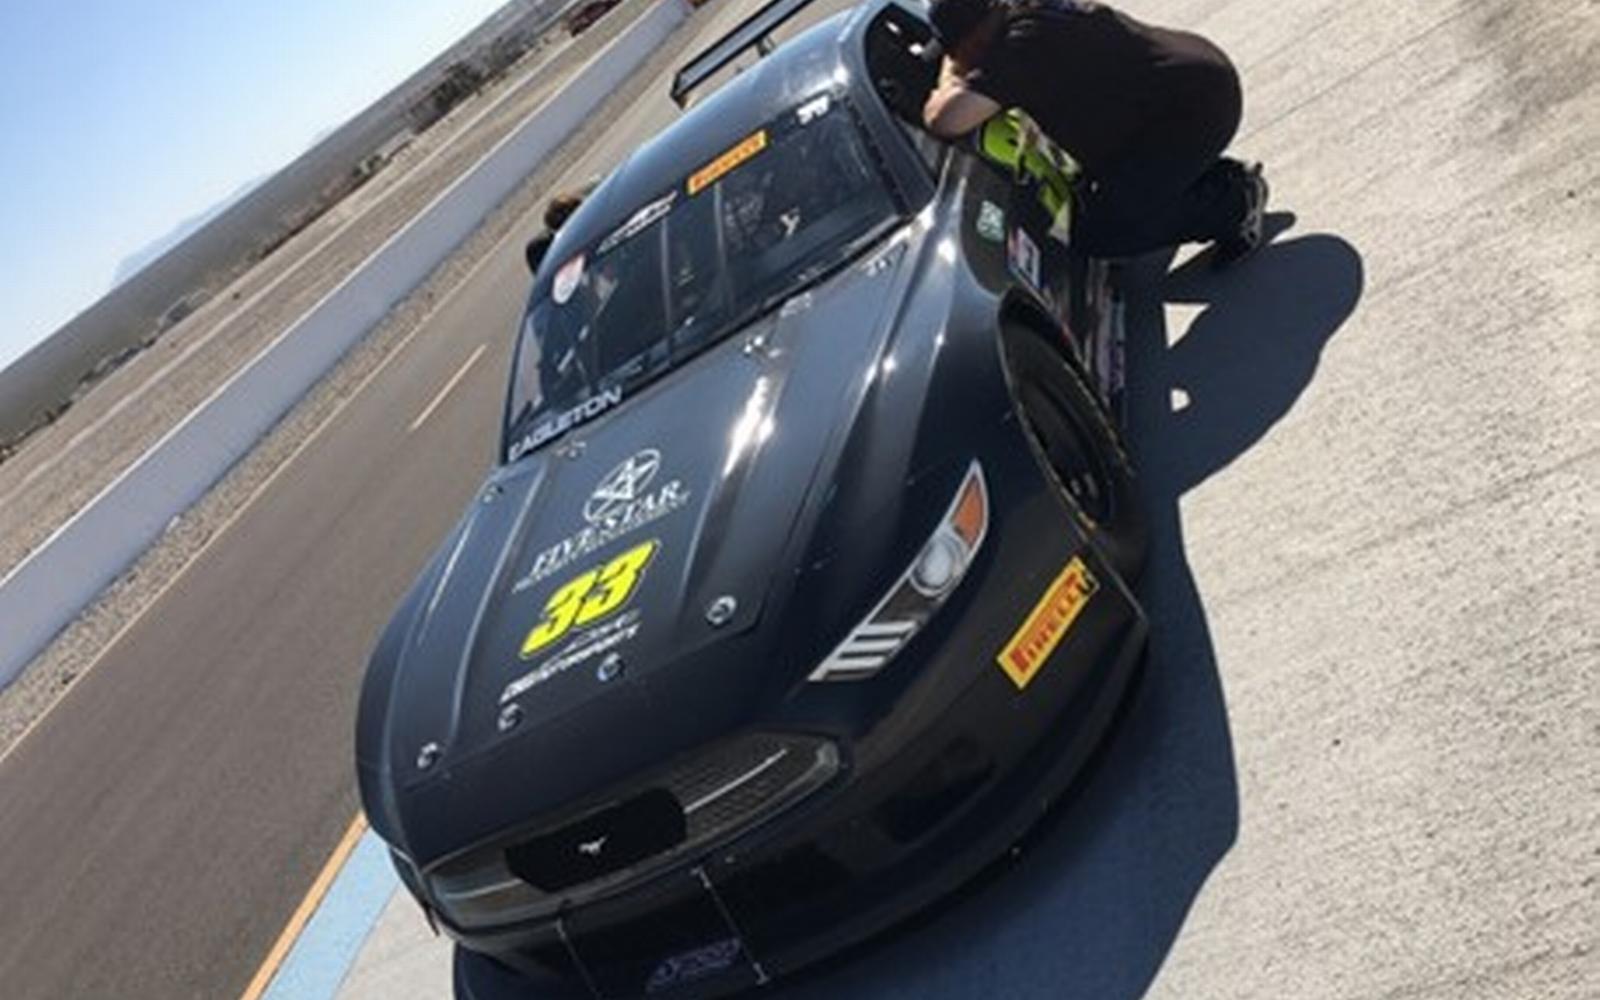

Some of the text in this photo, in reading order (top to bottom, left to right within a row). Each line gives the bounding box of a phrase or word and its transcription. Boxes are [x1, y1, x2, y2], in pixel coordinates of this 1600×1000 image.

[692, 132, 763, 189] PIRELLI
[509, 385, 622, 462] EAGLETON
[520, 538, 659, 659] 33
[1007, 568, 1087, 674] PIRELLI
